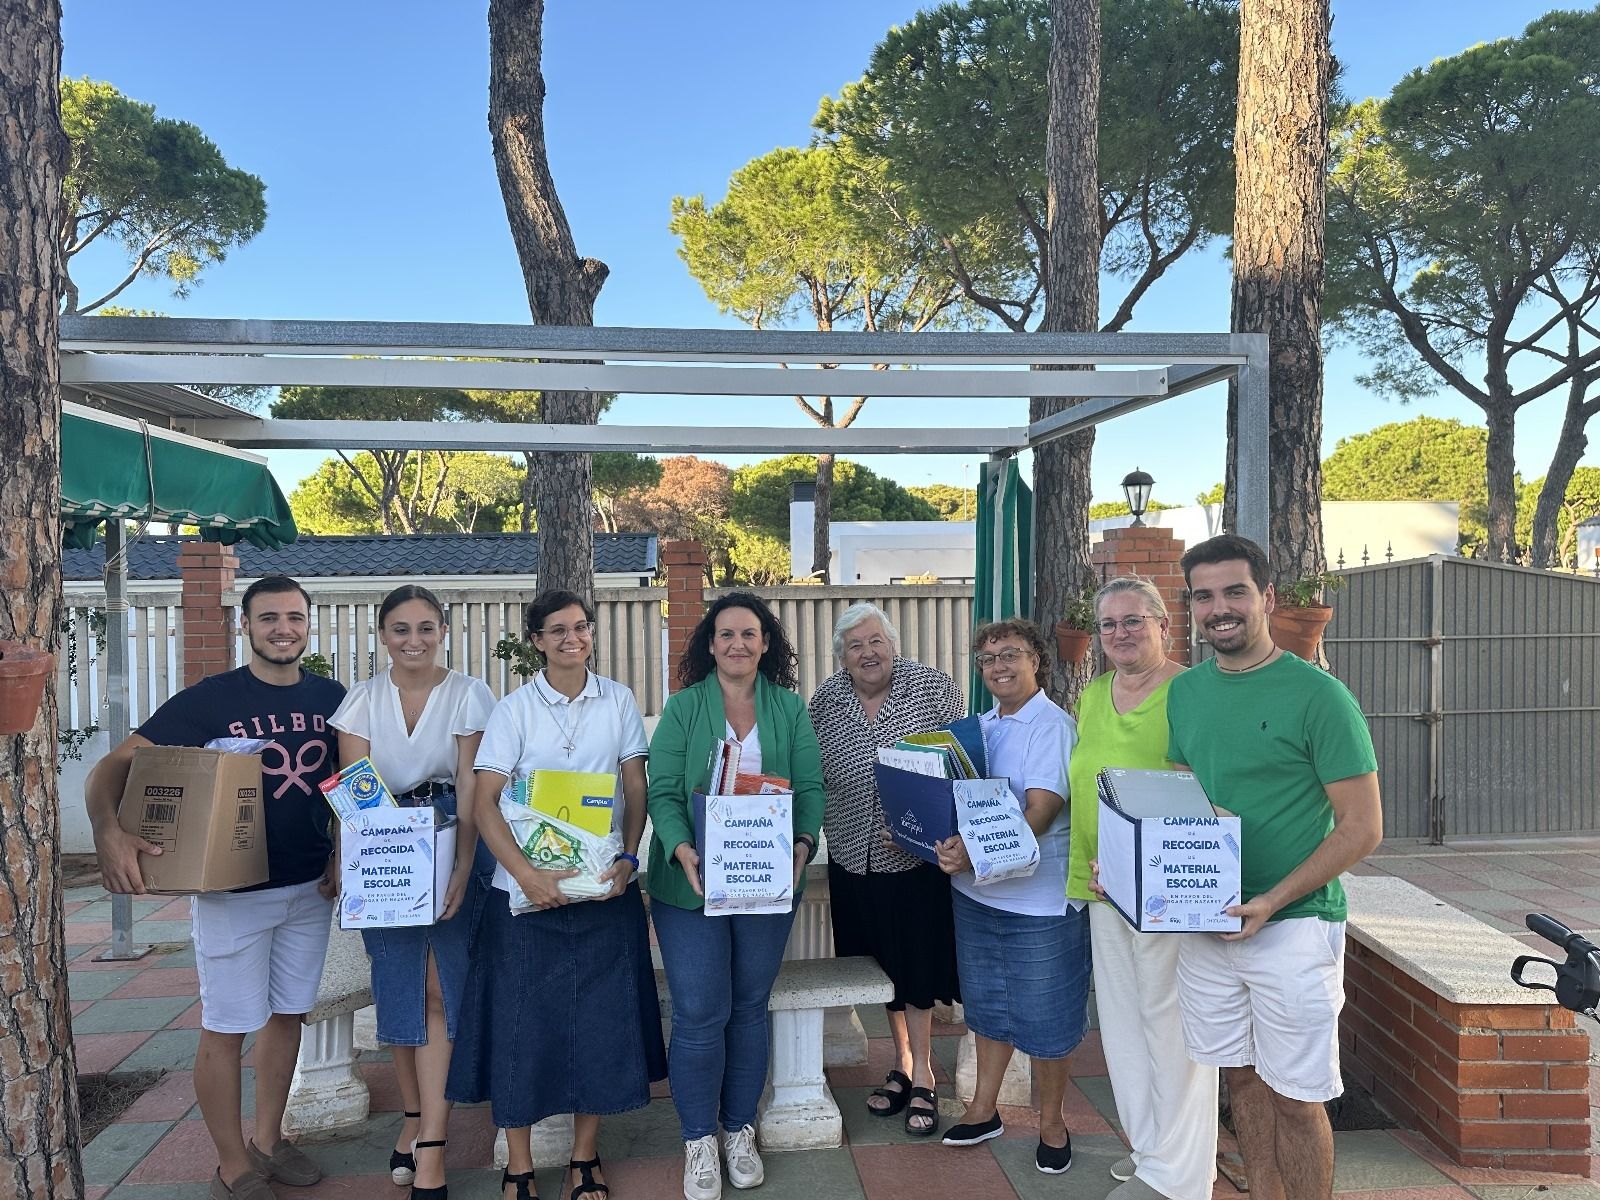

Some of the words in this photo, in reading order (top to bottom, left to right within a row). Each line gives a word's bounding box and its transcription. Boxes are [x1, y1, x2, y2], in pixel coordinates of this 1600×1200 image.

[229, 713, 336, 738] SILBO
[147, 787, 181, 796] 003226
[967, 798, 1002, 809] CAMPAÑA
[724, 817, 773, 828] CAMPAÑA
[969, 814, 1012, 826] RECOGIDA
[361, 825, 414, 836] CAMPAÑA
[977, 829, 1019, 843] MATERIAL
[723, 840, 774, 849] RECOGIDA
[983, 841, 1021, 853] ESCOLAR
[1162, 840, 1221, 849] RECOGIDA
[360, 845, 415, 856] RECOGIDA
[361, 866, 414, 876] MATERIAL
[723, 861, 774, 870] MATERIAL
[1163, 864, 1221, 874] MATERIAL
[363, 879, 411, 888] ESCOLAR
[726, 874, 772, 883] ESCOLAR
[1166, 878, 1218, 889] ESCOLAR
